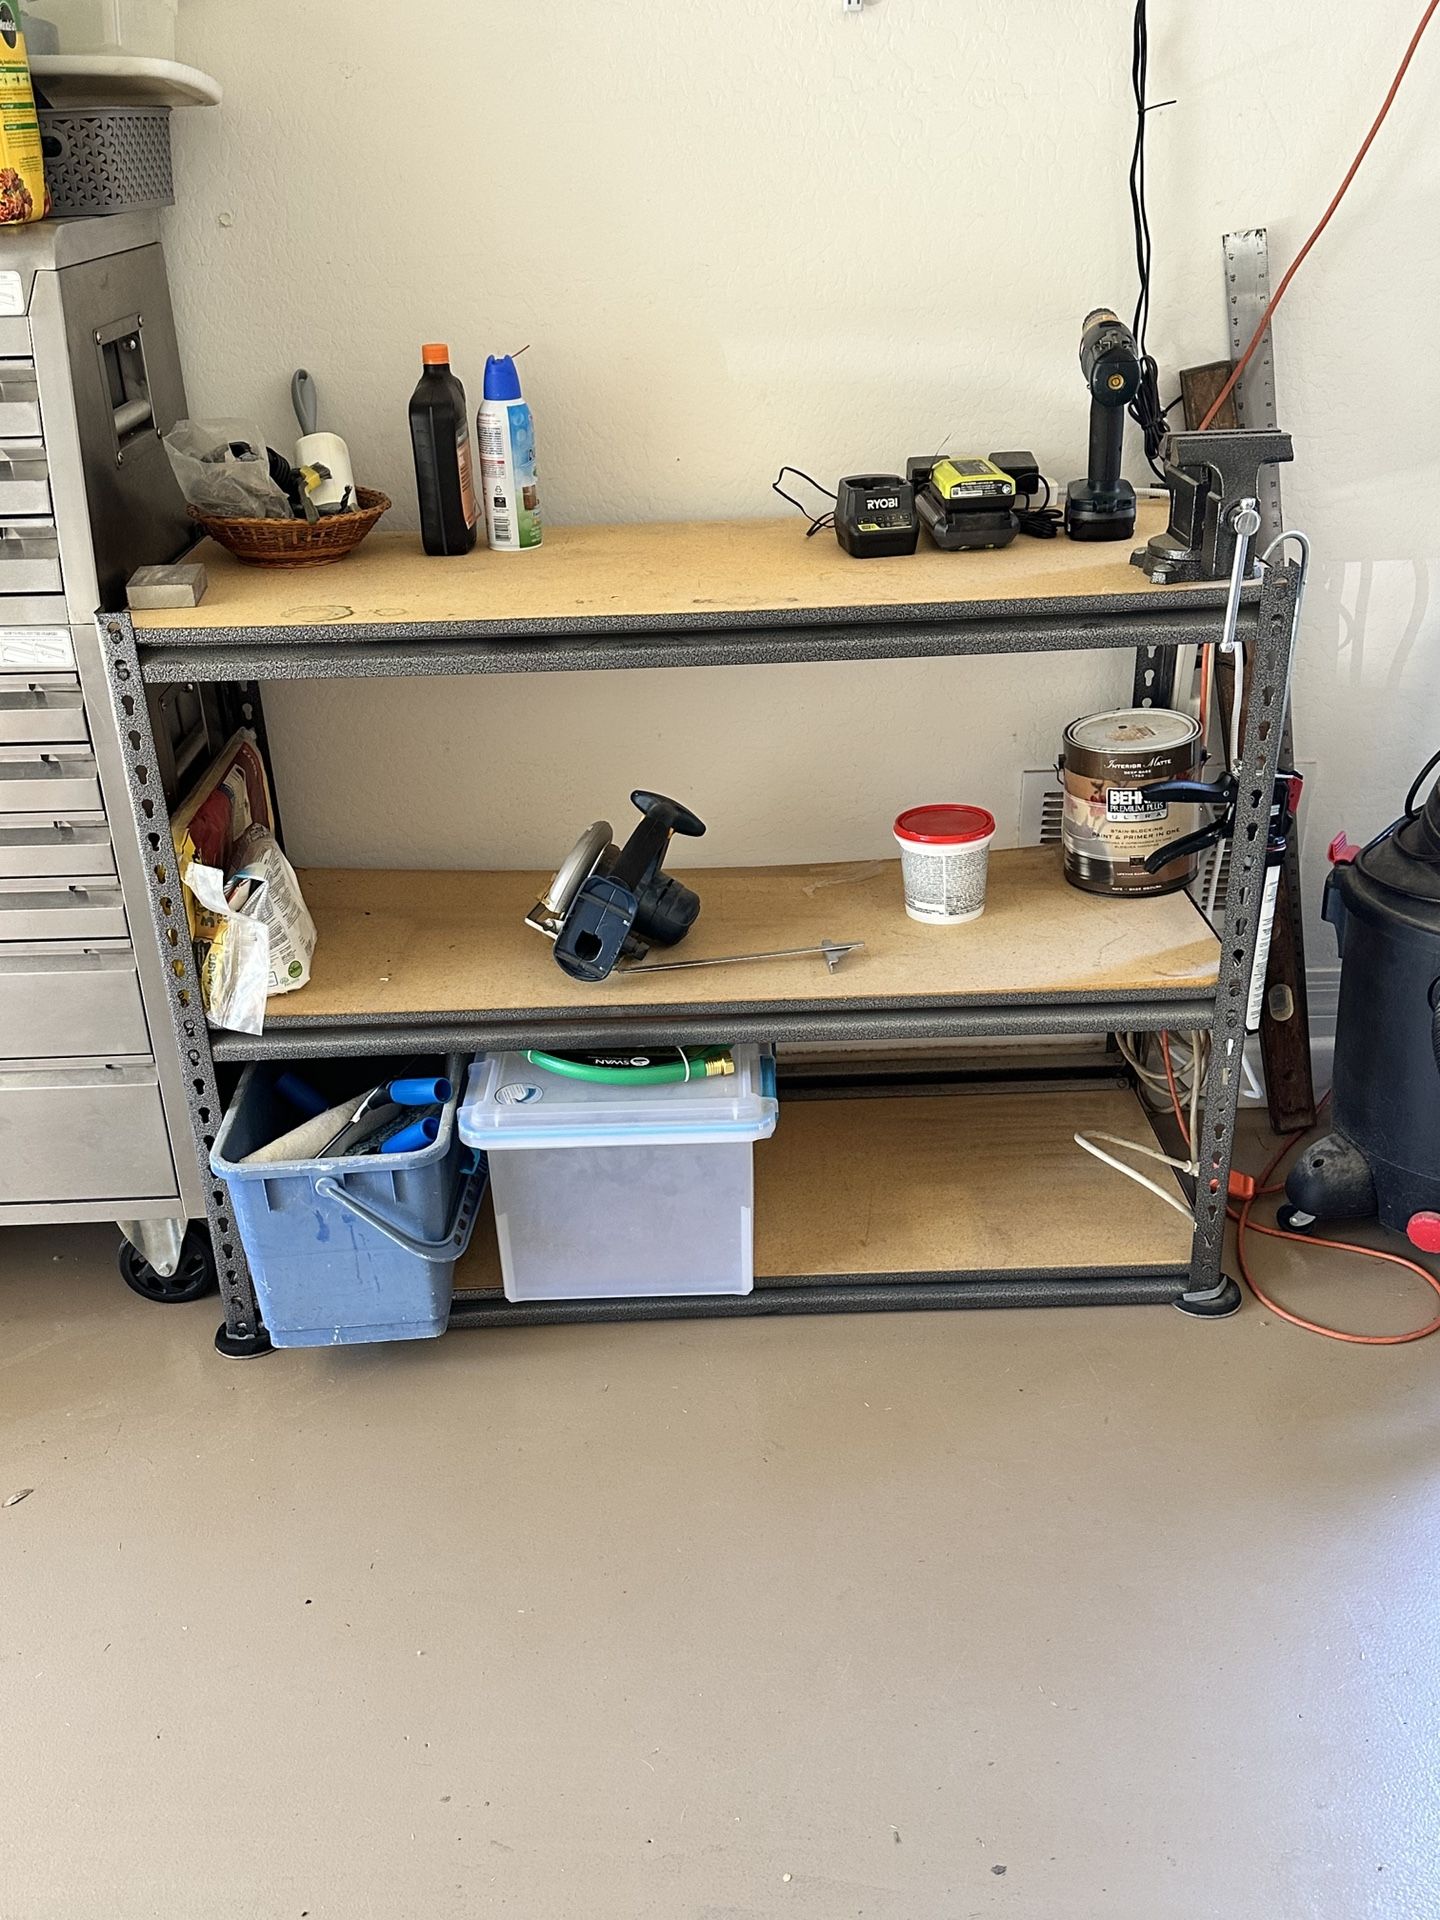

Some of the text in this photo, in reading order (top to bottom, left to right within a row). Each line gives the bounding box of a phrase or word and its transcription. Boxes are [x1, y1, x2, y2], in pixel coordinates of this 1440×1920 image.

[1232, 317, 1239, 326] 44
[866, 498, 898, 509] RYOBI
[1109, 801, 1164, 812] PREMIUM PLUS
[1092, 831, 1112, 840] PAINT
[1123, 832, 1154, 840] PRIMER
